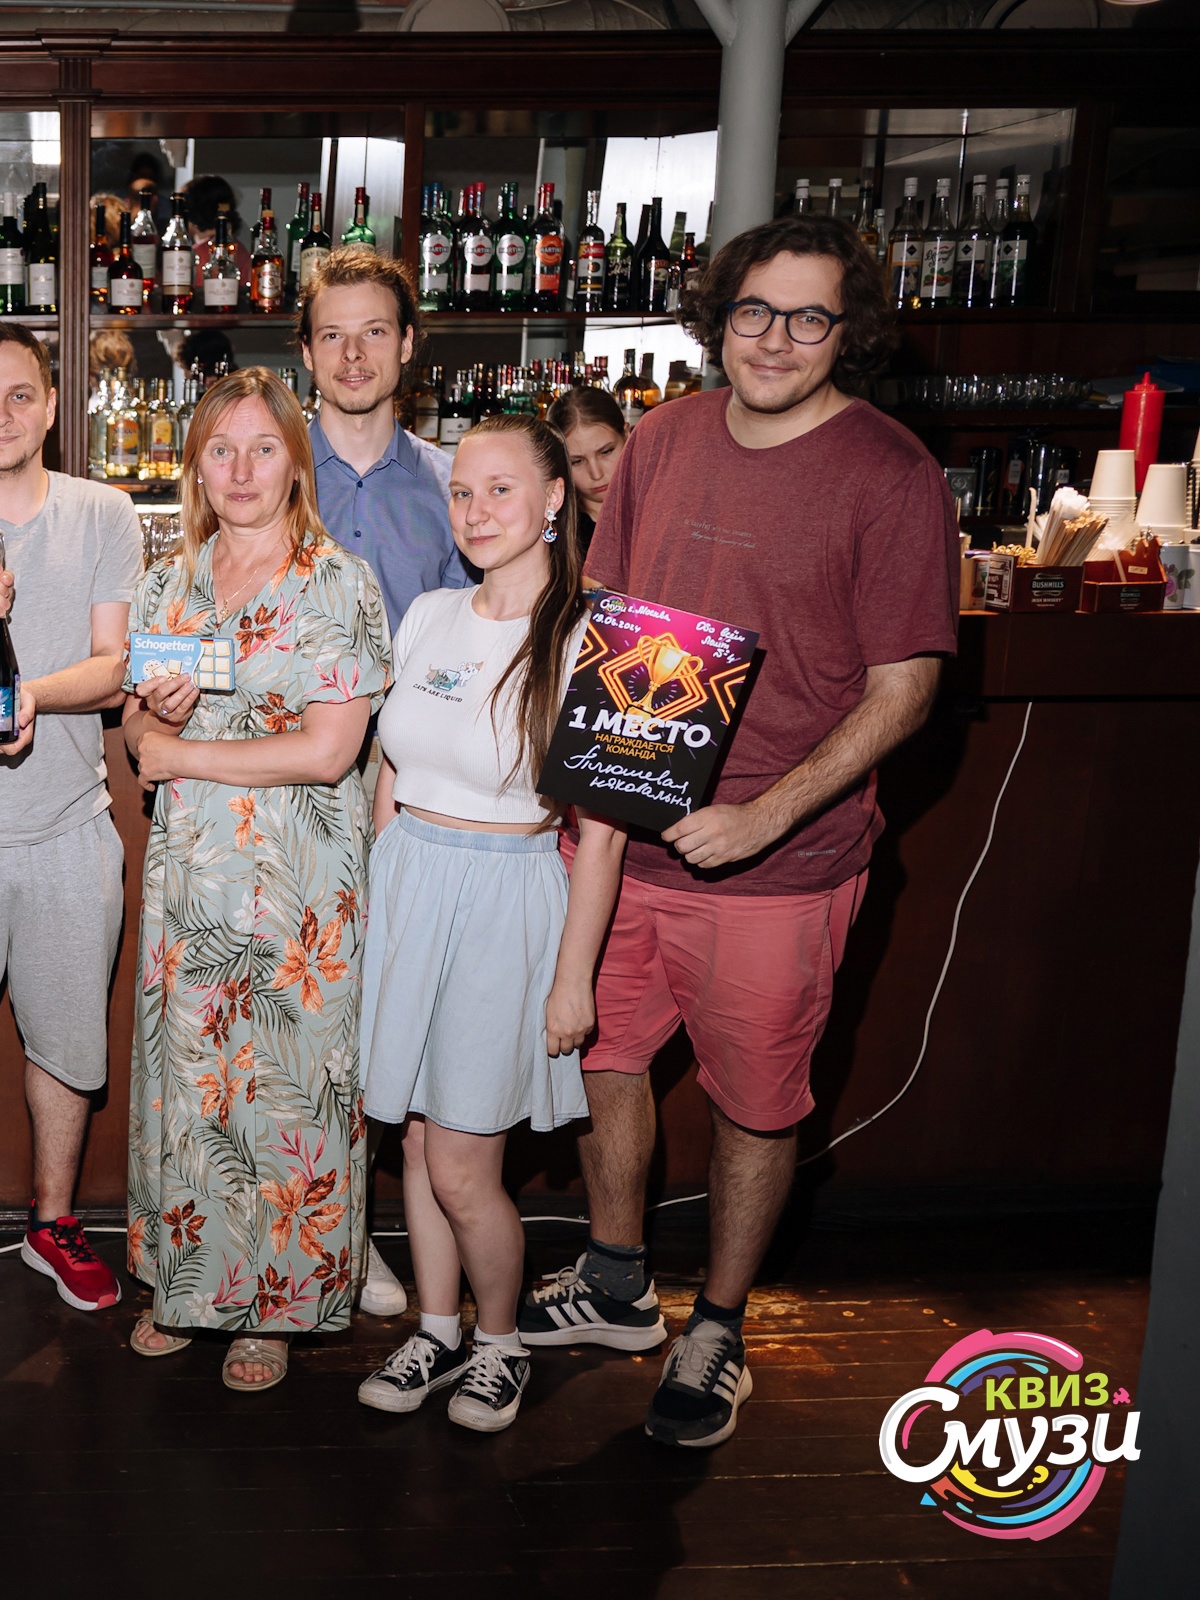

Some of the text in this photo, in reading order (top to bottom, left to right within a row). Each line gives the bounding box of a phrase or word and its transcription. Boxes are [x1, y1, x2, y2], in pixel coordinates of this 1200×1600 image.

[134, 638, 195, 653] Schogetten
[413, 683, 463, 702] CATS ARE LIQUID
[568, 705, 711, 748] 1 МЕСТО
[595, 733, 675, 754] НАГРАЖДАЕТСЯ
[606, 744, 656, 761] КОМАНДА
